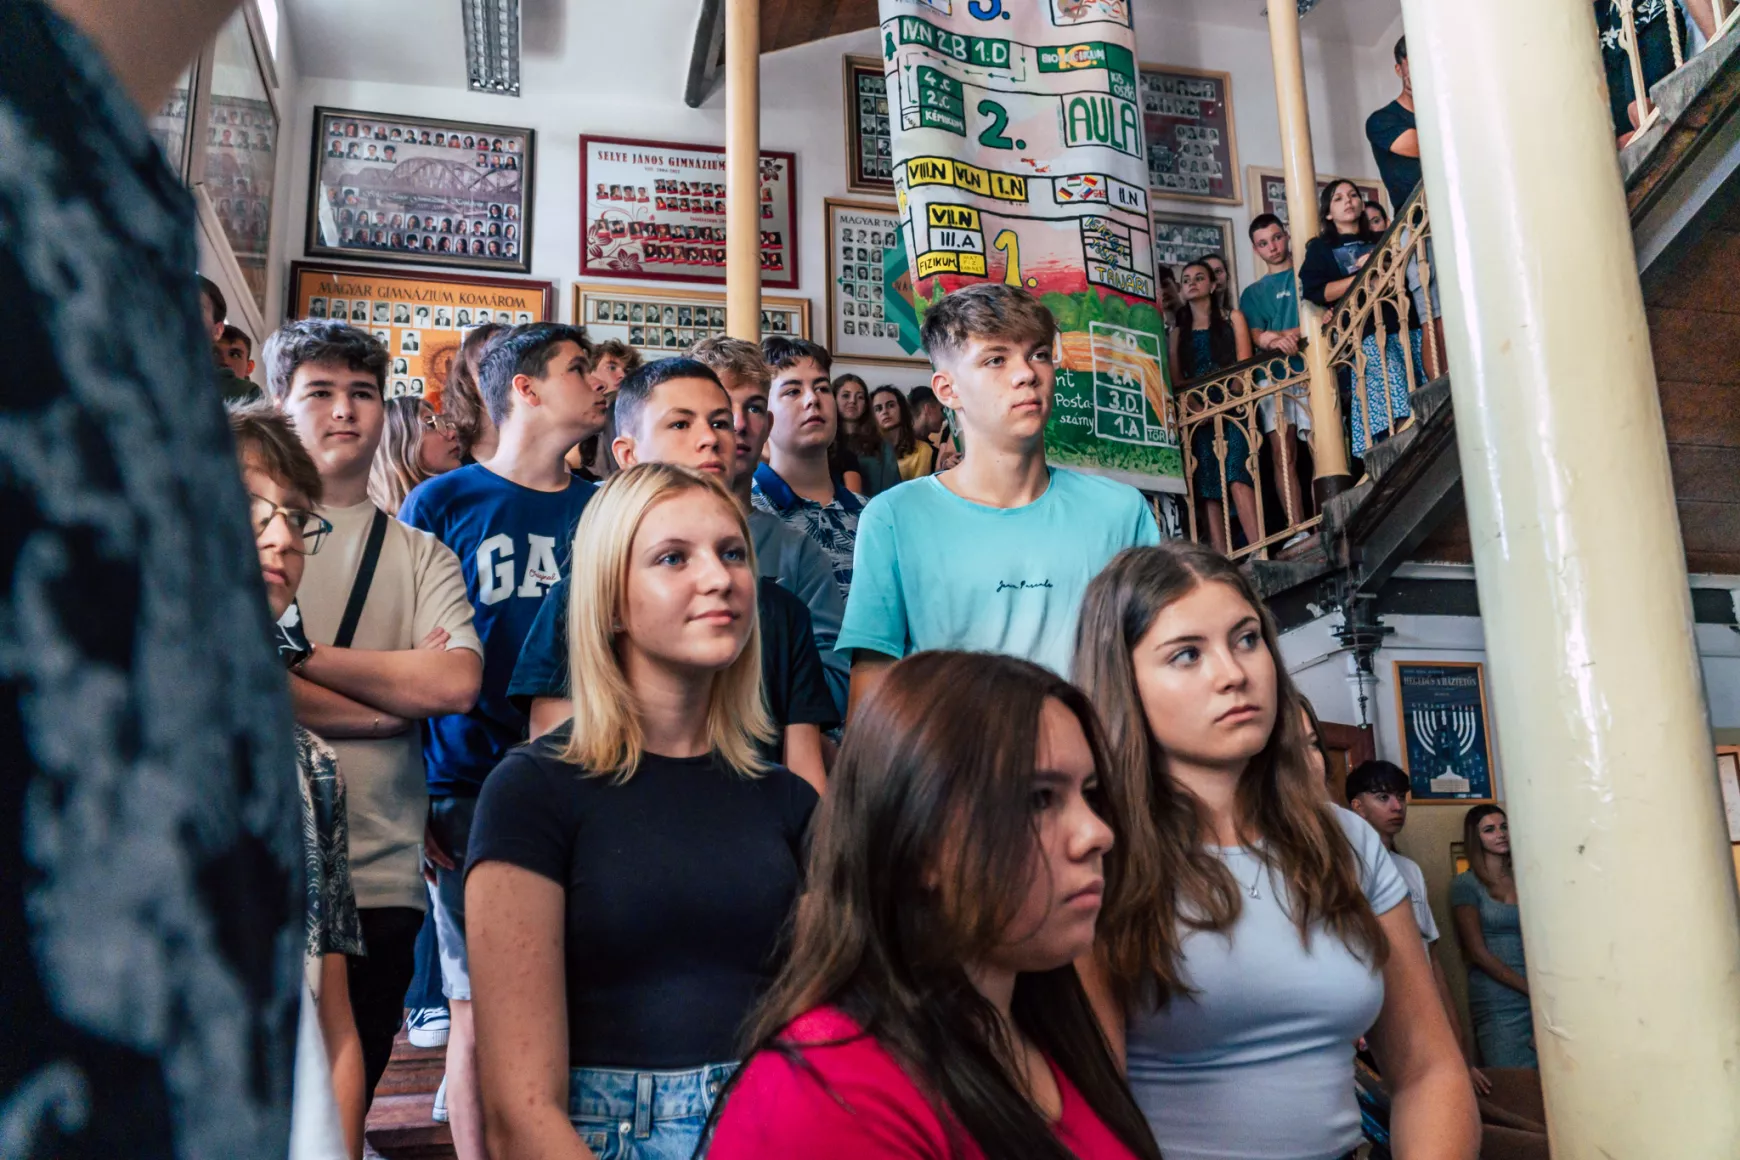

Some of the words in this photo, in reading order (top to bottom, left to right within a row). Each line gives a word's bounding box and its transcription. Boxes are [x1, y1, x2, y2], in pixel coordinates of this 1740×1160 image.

[977, 100, 1027, 150] 2.
[1068, 96, 1139, 155] AULA
[597, 150, 628, 162] SELYE
[632, 153, 664, 166] JÁNOS
[668, 156, 726, 171] GIMNÁZIUM
[908, 160, 946, 180] VIII.N
[998, 176, 1023, 196] I.N
[1118, 187, 1139, 206] II.N
[840, 215, 881, 227] MAGYAR
[931, 207, 972, 228] VII.N
[940, 231, 975, 248] III.A
[919, 257, 959, 273] FIZIKUM
[993, 229, 1038, 288] 1.
[1094, 266, 1149, 295] TANÁRI
[318, 281, 373, 296] MAGYAR
[459, 292, 526, 308] KOMÁROM
[1108, 390, 1139, 413] 3.D.
[1114, 415, 1140, 438] 1.A
[476, 533, 562, 606] GA
[529, 568, 556, 581] Original
